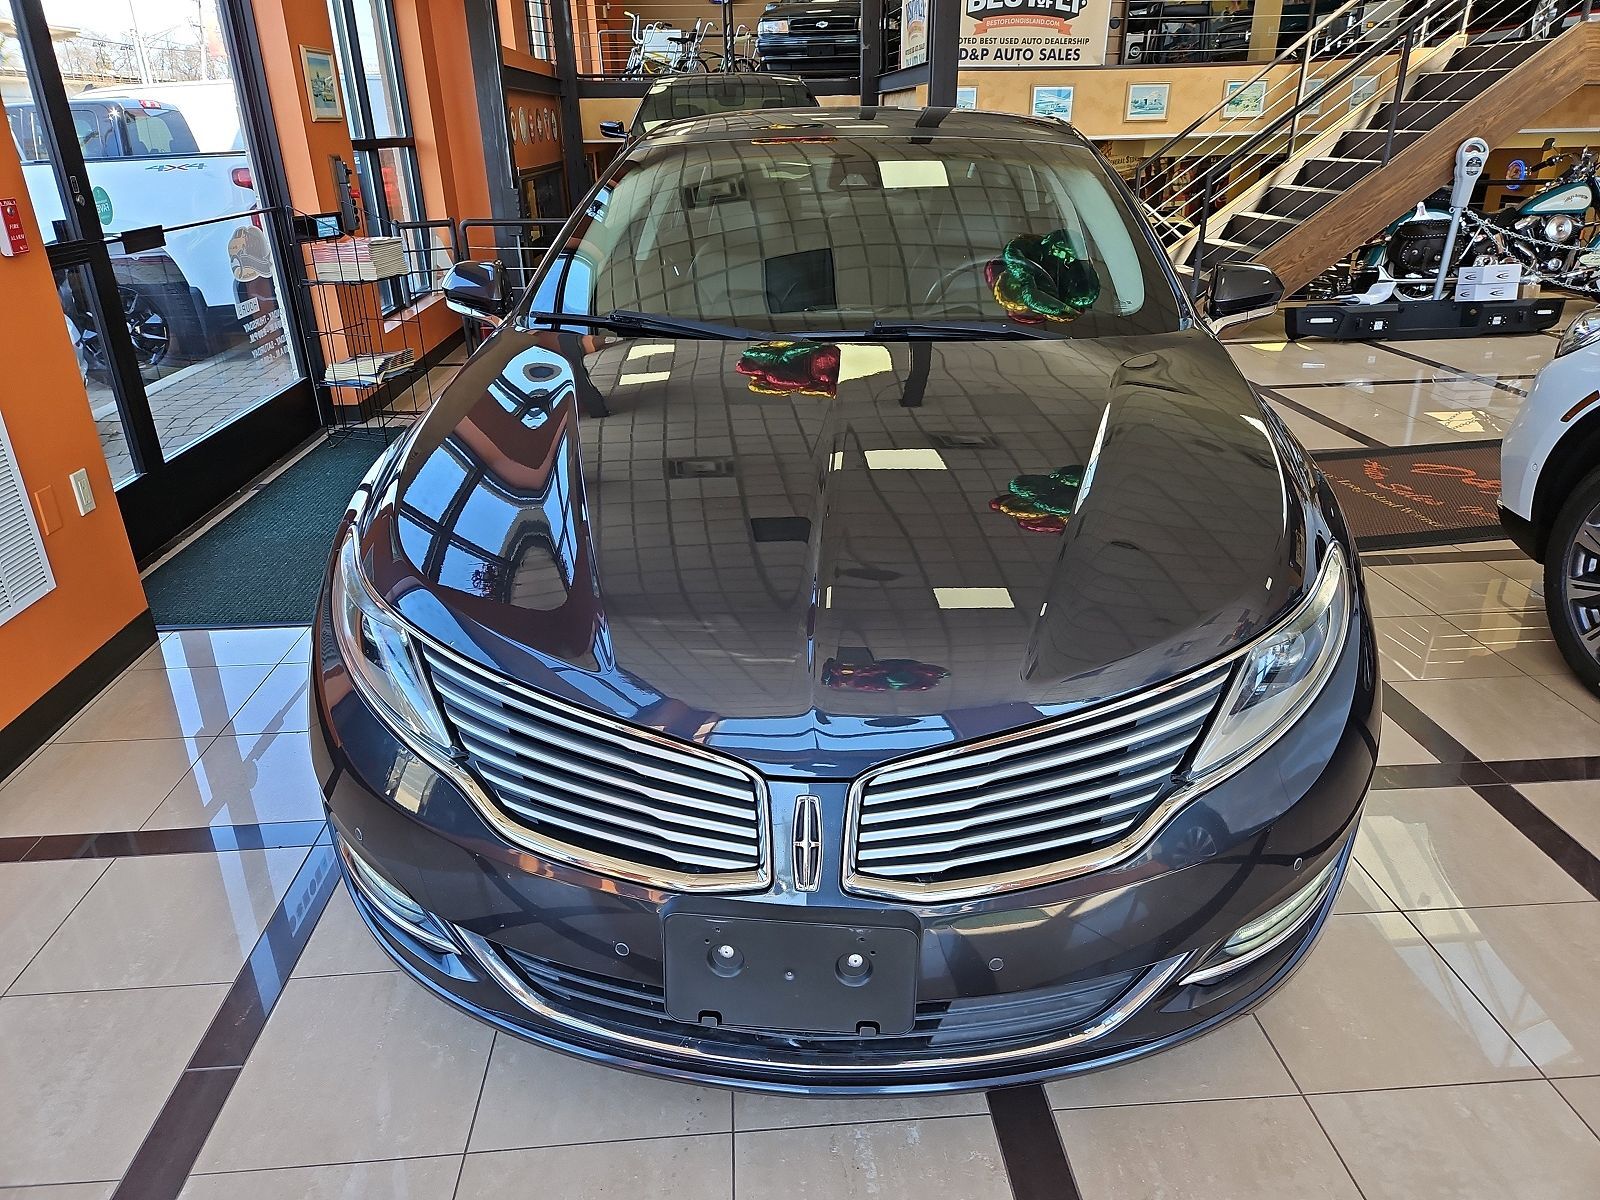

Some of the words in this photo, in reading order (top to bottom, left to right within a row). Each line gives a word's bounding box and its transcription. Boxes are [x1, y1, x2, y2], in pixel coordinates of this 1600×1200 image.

[986, 18, 1061, 27] BESTOFLONGISLAND.COM
[958, 37, 977, 45] OTED
[979, 37, 998, 45] BEST
[999, 37, 1020, 45] USED
[1021, 37, 1043, 45] AUTO
[1044, 37, 1090, 46] DEALERSHIP
[958, 47, 990, 61] D&P
[993, 47, 1034, 61] AUTO
[1038, 47, 1081, 61] SALES
